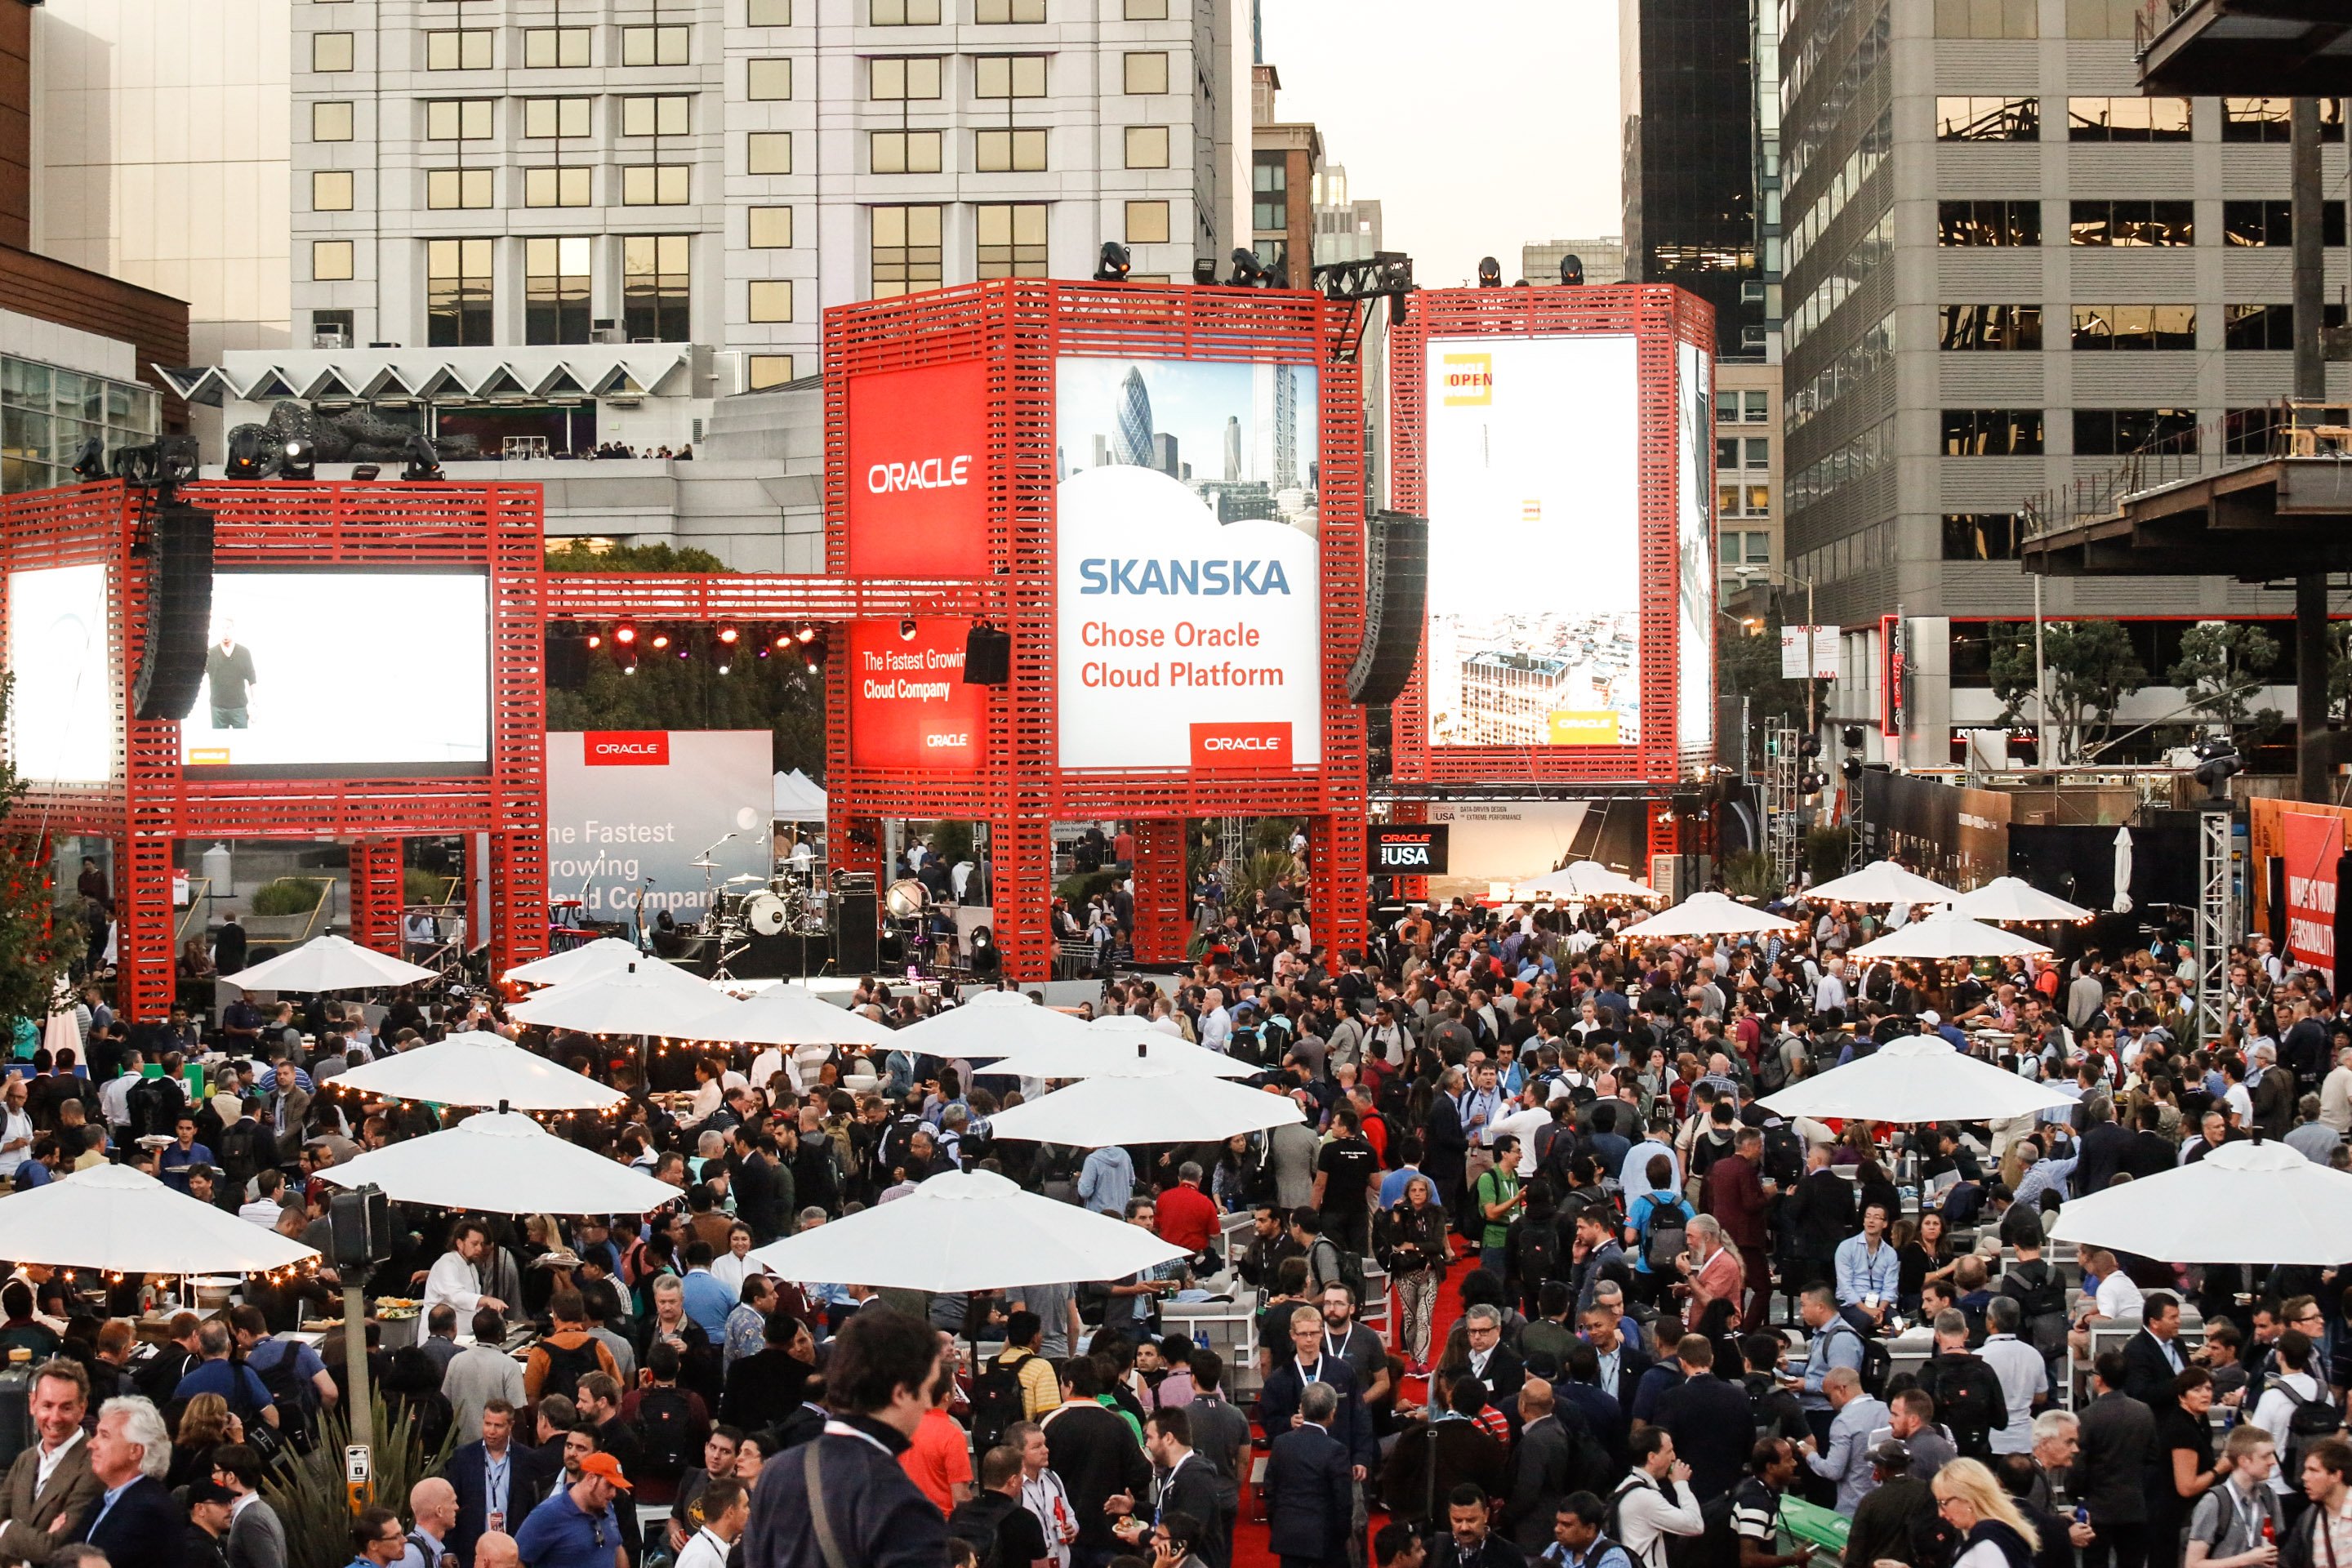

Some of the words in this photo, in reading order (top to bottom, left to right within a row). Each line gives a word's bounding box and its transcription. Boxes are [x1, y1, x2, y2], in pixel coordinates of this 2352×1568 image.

[1450, 373, 1492, 386] OPEN
[868, 455, 969, 493] ORACLE
[1080, 559, 1290, 595] SKANSKA
[1081, 621, 1165, 647] Chose
[1174, 621, 1260, 647] Oracle
[862, 652, 883, 670] The
[886, 651, 924, 670] Fastest
[926, 648, 966, 669] Growin
[1081, 662, 1159, 688] Cloud
[1170, 662, 1284, 687] Platform
[864, 679, 895, 699] Cloud
[898, 679, 950, 702] Company
[596, 744, 657, 754] ORACLE
[927, 733, 968, 747] ORACLE
[1205, 737, 1279, 751] ORACLE
[1436, 813, 1455, 821] USA
[547, 821, 575, 844] he
[586, 821, 675, 844] Fastest
[1381, 834, 1431, 843] ORACLE
[1388, 847, 1428, 865] USA
[550, 858, 639, 881] rowing
[548, 887, 600, 910] loud
[609, 886, 710, 914] Compan
[2290, 875, 2309, 908] WHAT
[2310, 879, 2317, 911] IS
[2318, 880, 2336, 914] YOUR
[2291, 917, 2335, 957] PERSONALITY
